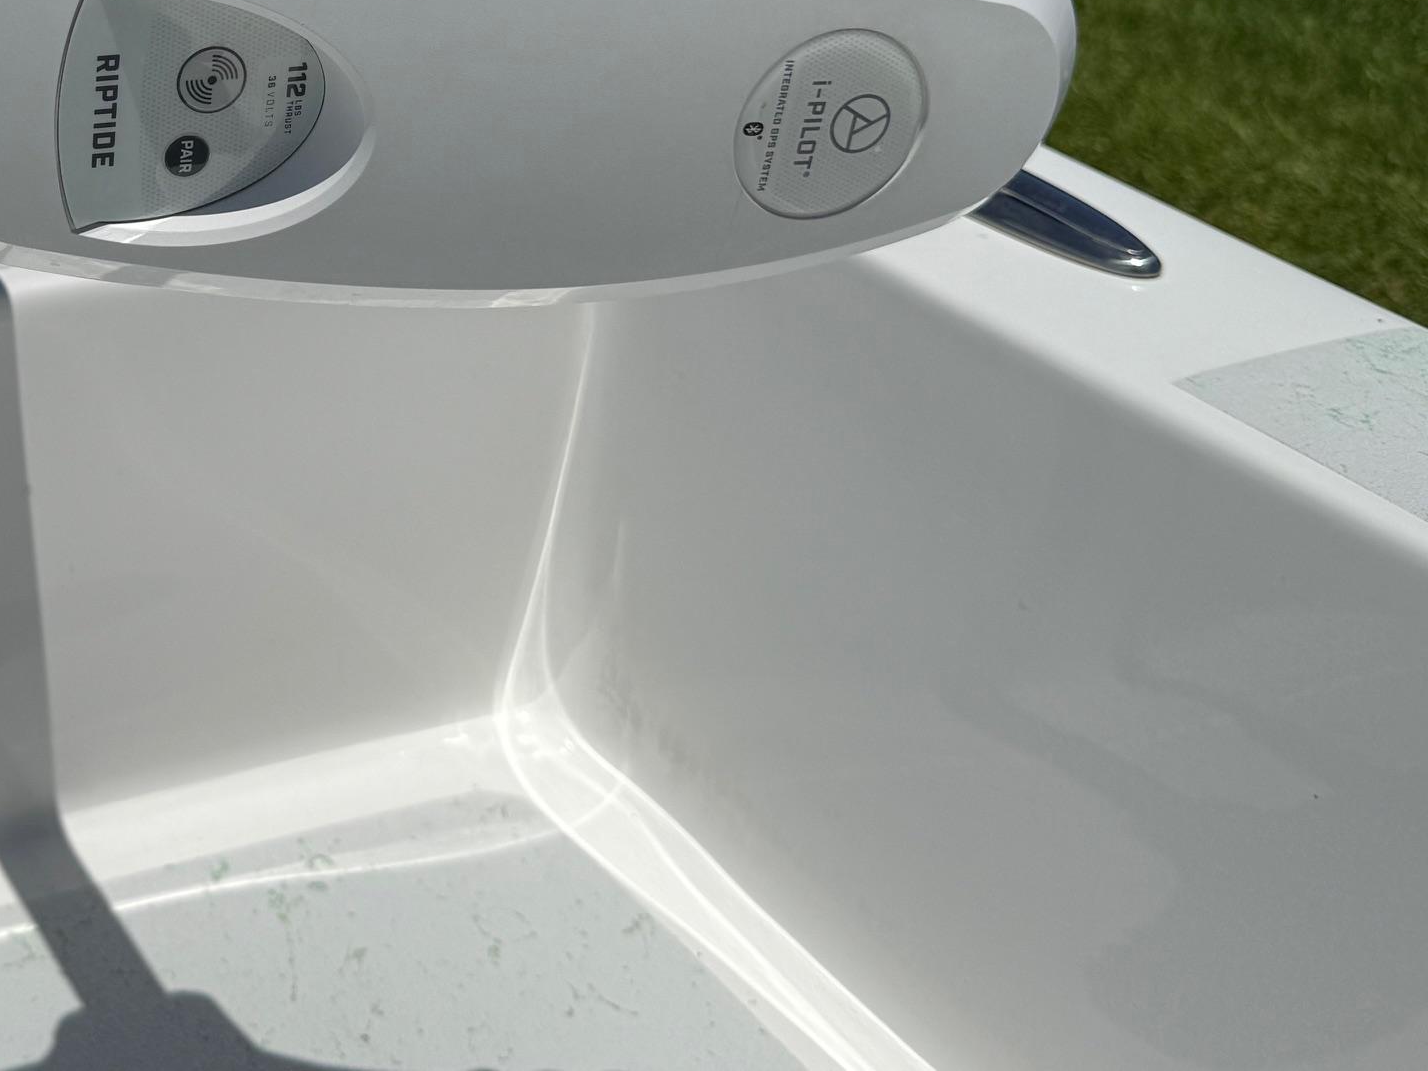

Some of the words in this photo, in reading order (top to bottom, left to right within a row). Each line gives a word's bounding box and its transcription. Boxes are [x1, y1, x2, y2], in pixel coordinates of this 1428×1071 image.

[286, 62, 308, 98] 112
[773, 60, 795, 125] INTEGRATED
[91, 53, 121, 169] RIPTIDE
[264, 92, 275, 129] VOLTS
[284, 100, 295, 135] THRUST
[293, 99, 303, 117] LBS
[179, 140, 194, 173] PAIR
[767, 128, 780, 149] GPS
[757, 151, 775, 192] SYSTEM
